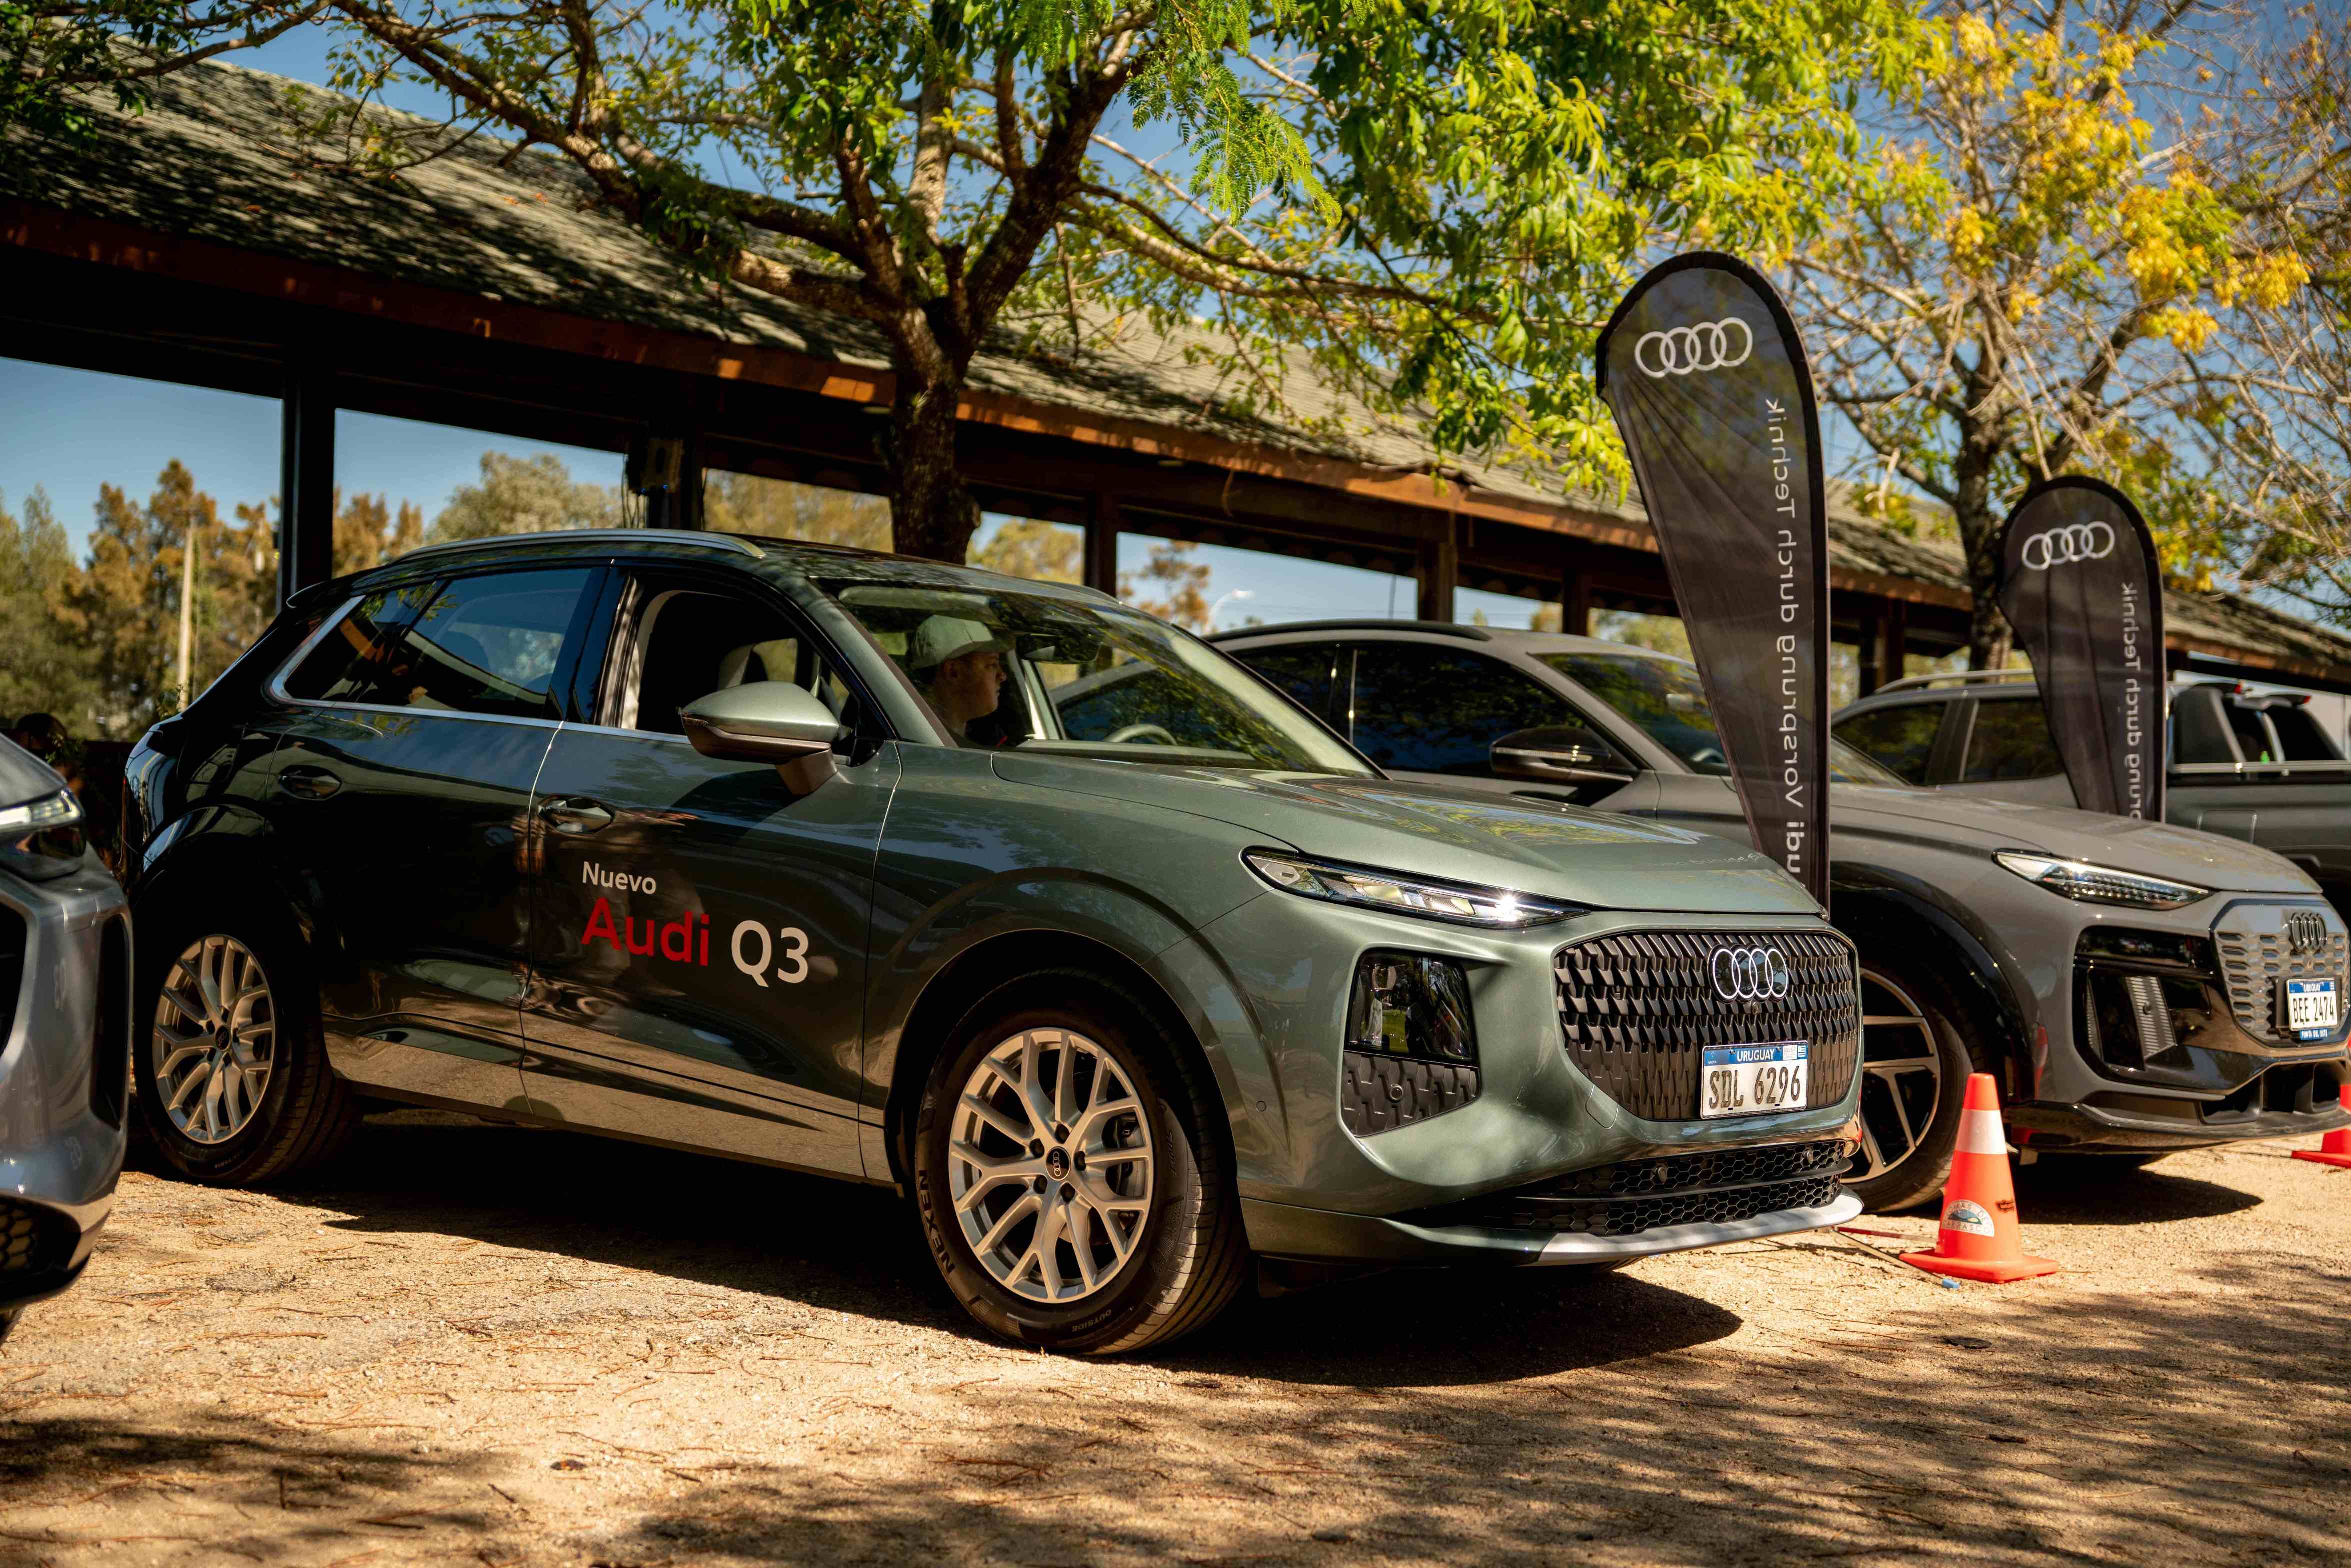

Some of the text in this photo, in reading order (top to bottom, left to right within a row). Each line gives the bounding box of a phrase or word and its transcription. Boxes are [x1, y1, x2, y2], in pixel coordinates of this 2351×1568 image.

[582, 861, 656, 894] Nuevo
[581, 897, 809, 987] Audi Q3
[2293, 996, 2334, 1023] BEE 2474
[1737, 1049, 1775, 1062] URUGUAY
[1709, 1066, 1800, 1109] SDL 6296
[919, 1170, 955, 1275] NEXEN
[1071, 1309, 1112, 1332] OUTSIDE
